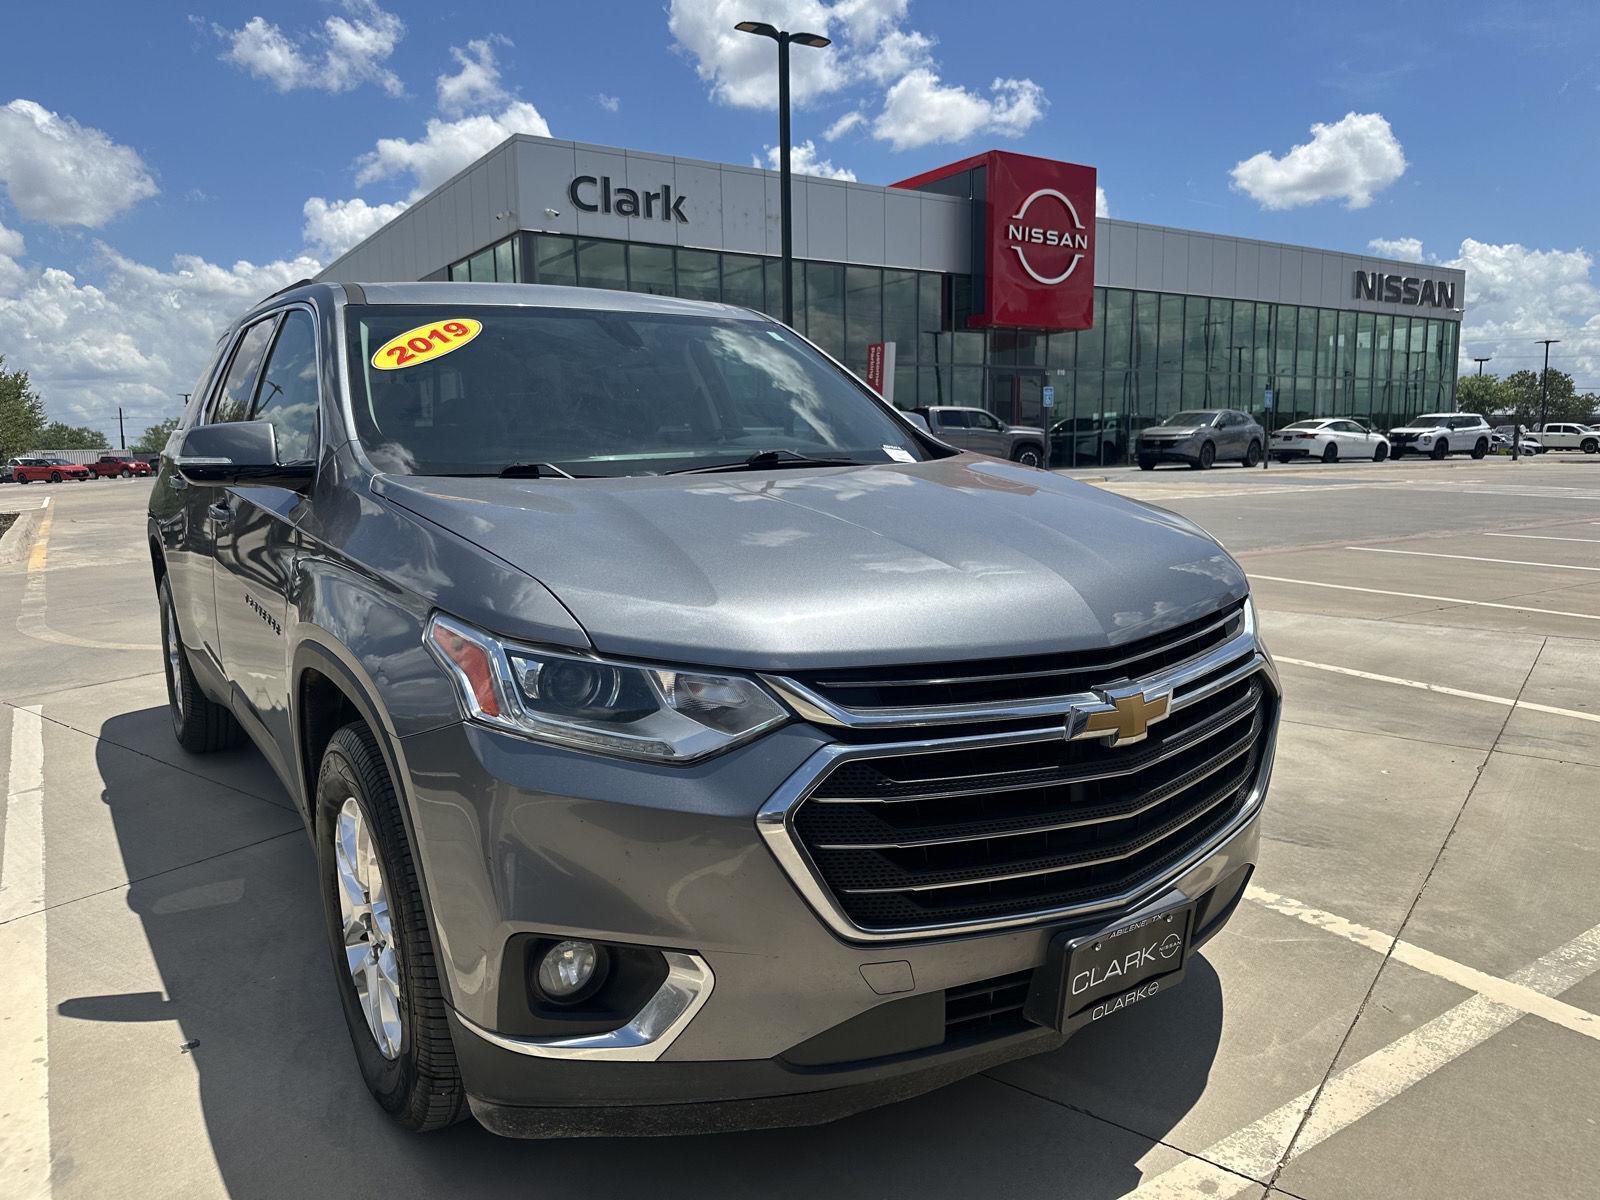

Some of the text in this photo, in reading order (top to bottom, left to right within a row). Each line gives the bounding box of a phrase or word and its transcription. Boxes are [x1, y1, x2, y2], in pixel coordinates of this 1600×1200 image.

[568, 175, 689, 224] Clark
[1008, 224, 1088, 250] NISSAN
[1354, 270, 1456, 309] NISSAN
[386, 322, 470, 366] 2019
[868, 346, 876, 379] Parking
[1152, 914, 1163, 923] TX
[1072, 942, 1158, 996] CLARK
[1092, 986, 1148, 1021] CLARK
